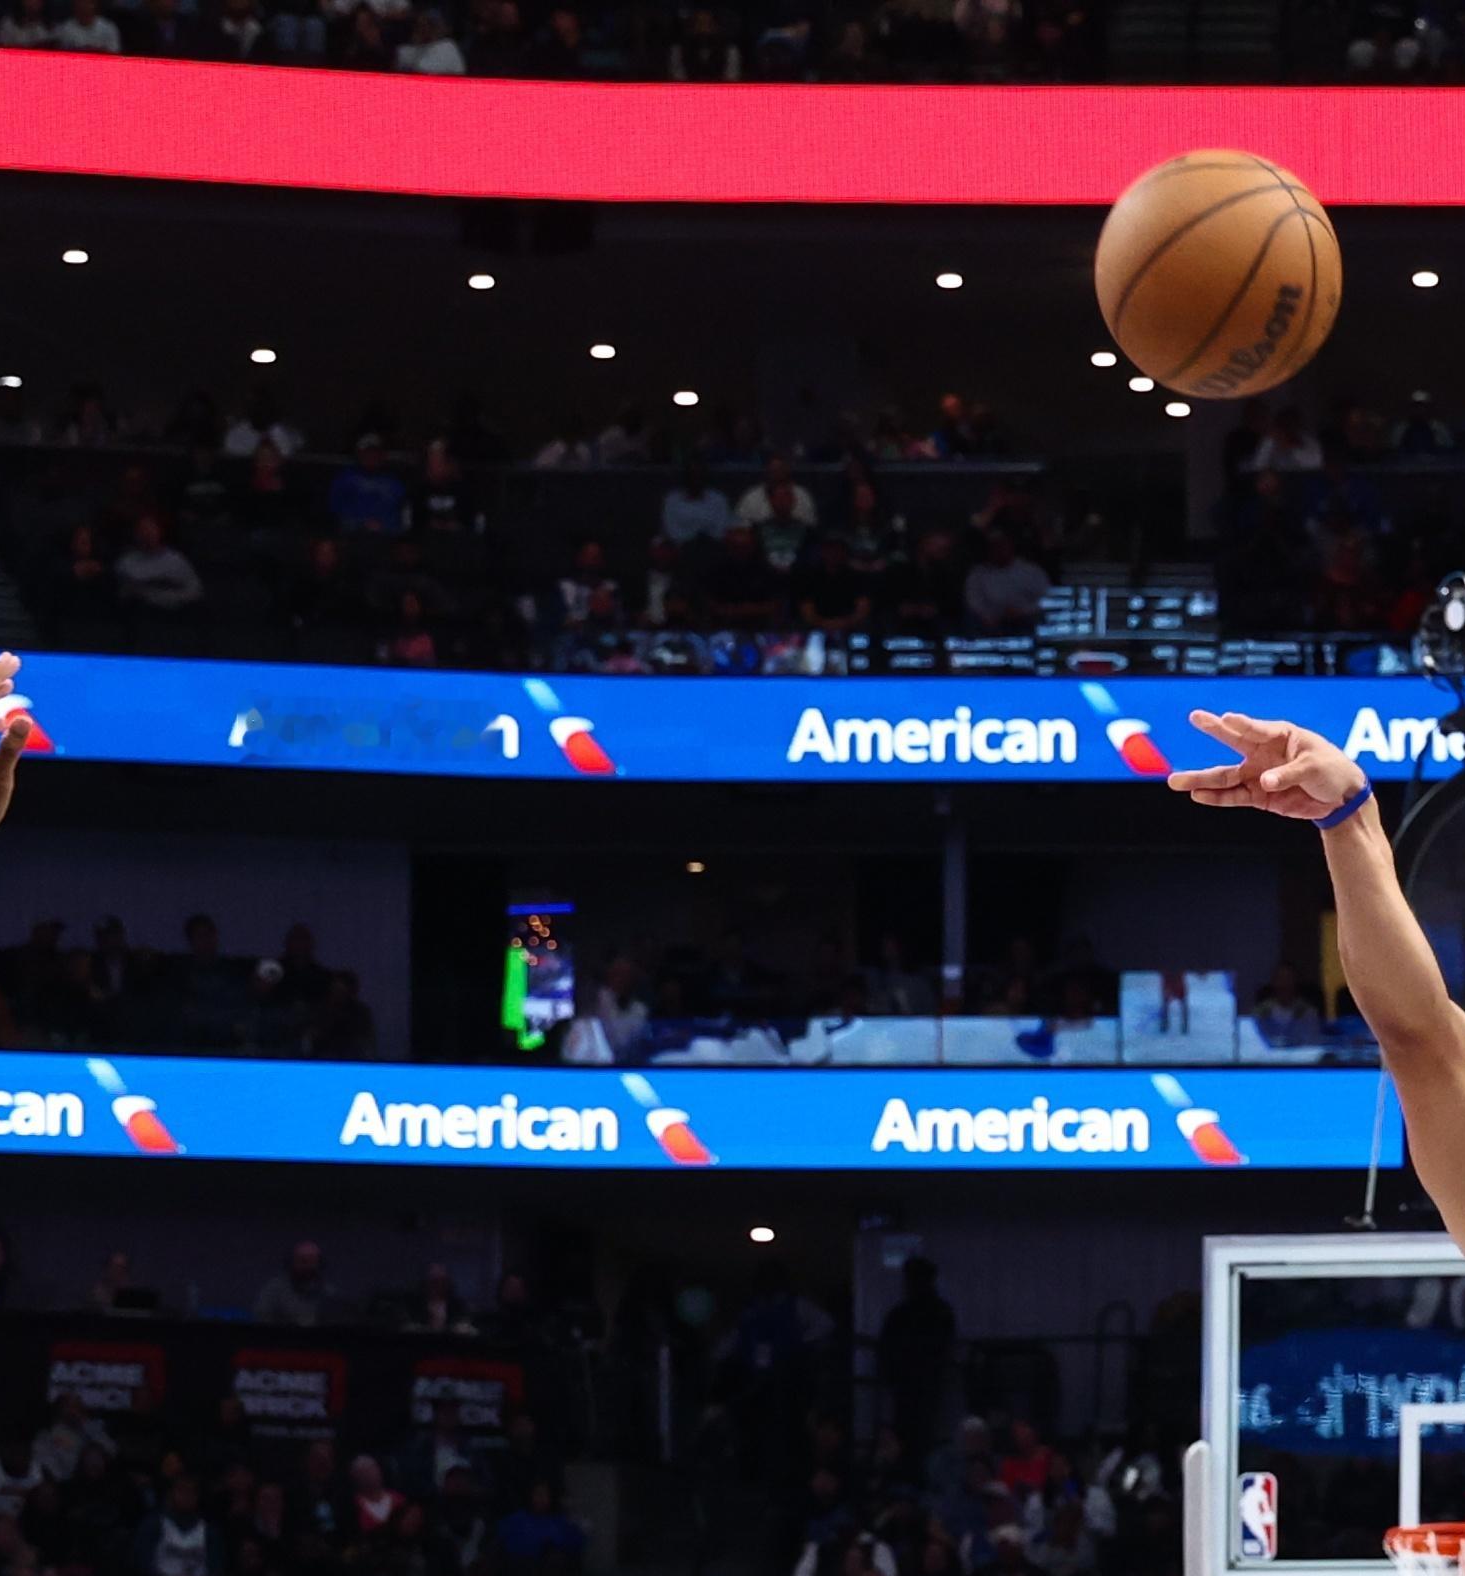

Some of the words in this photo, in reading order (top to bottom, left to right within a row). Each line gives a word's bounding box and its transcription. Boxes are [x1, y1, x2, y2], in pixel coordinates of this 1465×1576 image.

[1189, 284, 1302, 397] Wilson
[788, 707, 1077, 764] American
[340, 1092, 618, 1151] American
[871, 1097, 1149, 1152] American
